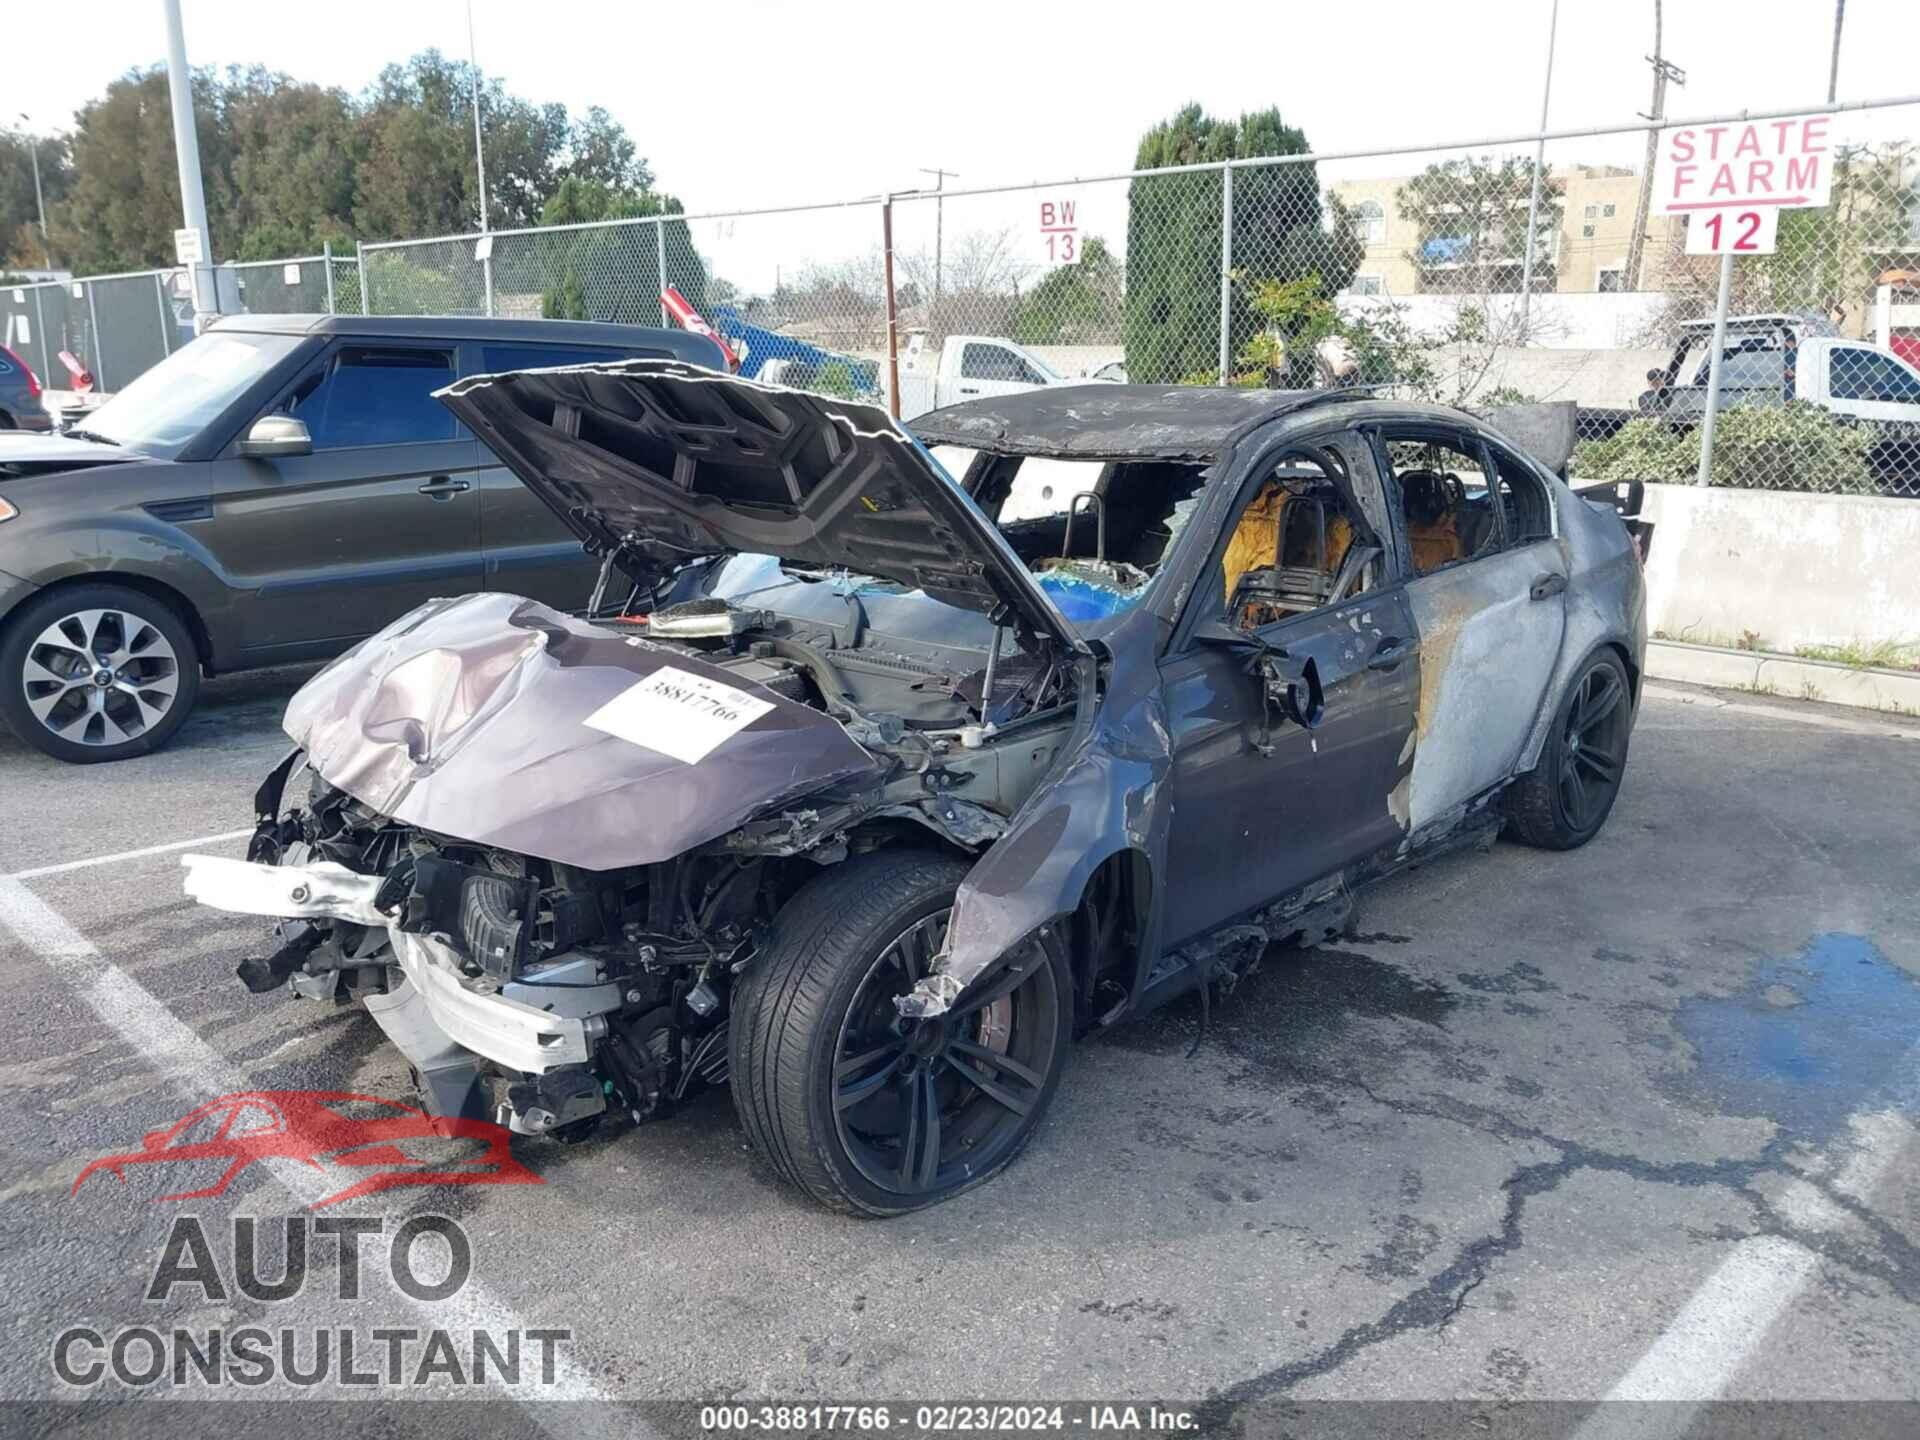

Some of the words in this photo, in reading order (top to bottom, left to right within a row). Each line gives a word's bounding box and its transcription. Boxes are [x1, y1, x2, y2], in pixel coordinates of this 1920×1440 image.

[1670, 117, 1831, 162] STATE
[1673, 156, 1819, 198] FARM
[1040, 199, 1076, 226] BW
[1704, 211, 1762, 251] 12
[1045, 234, 1075, 262] 13
[645, 681, 741, 721] 38817766
